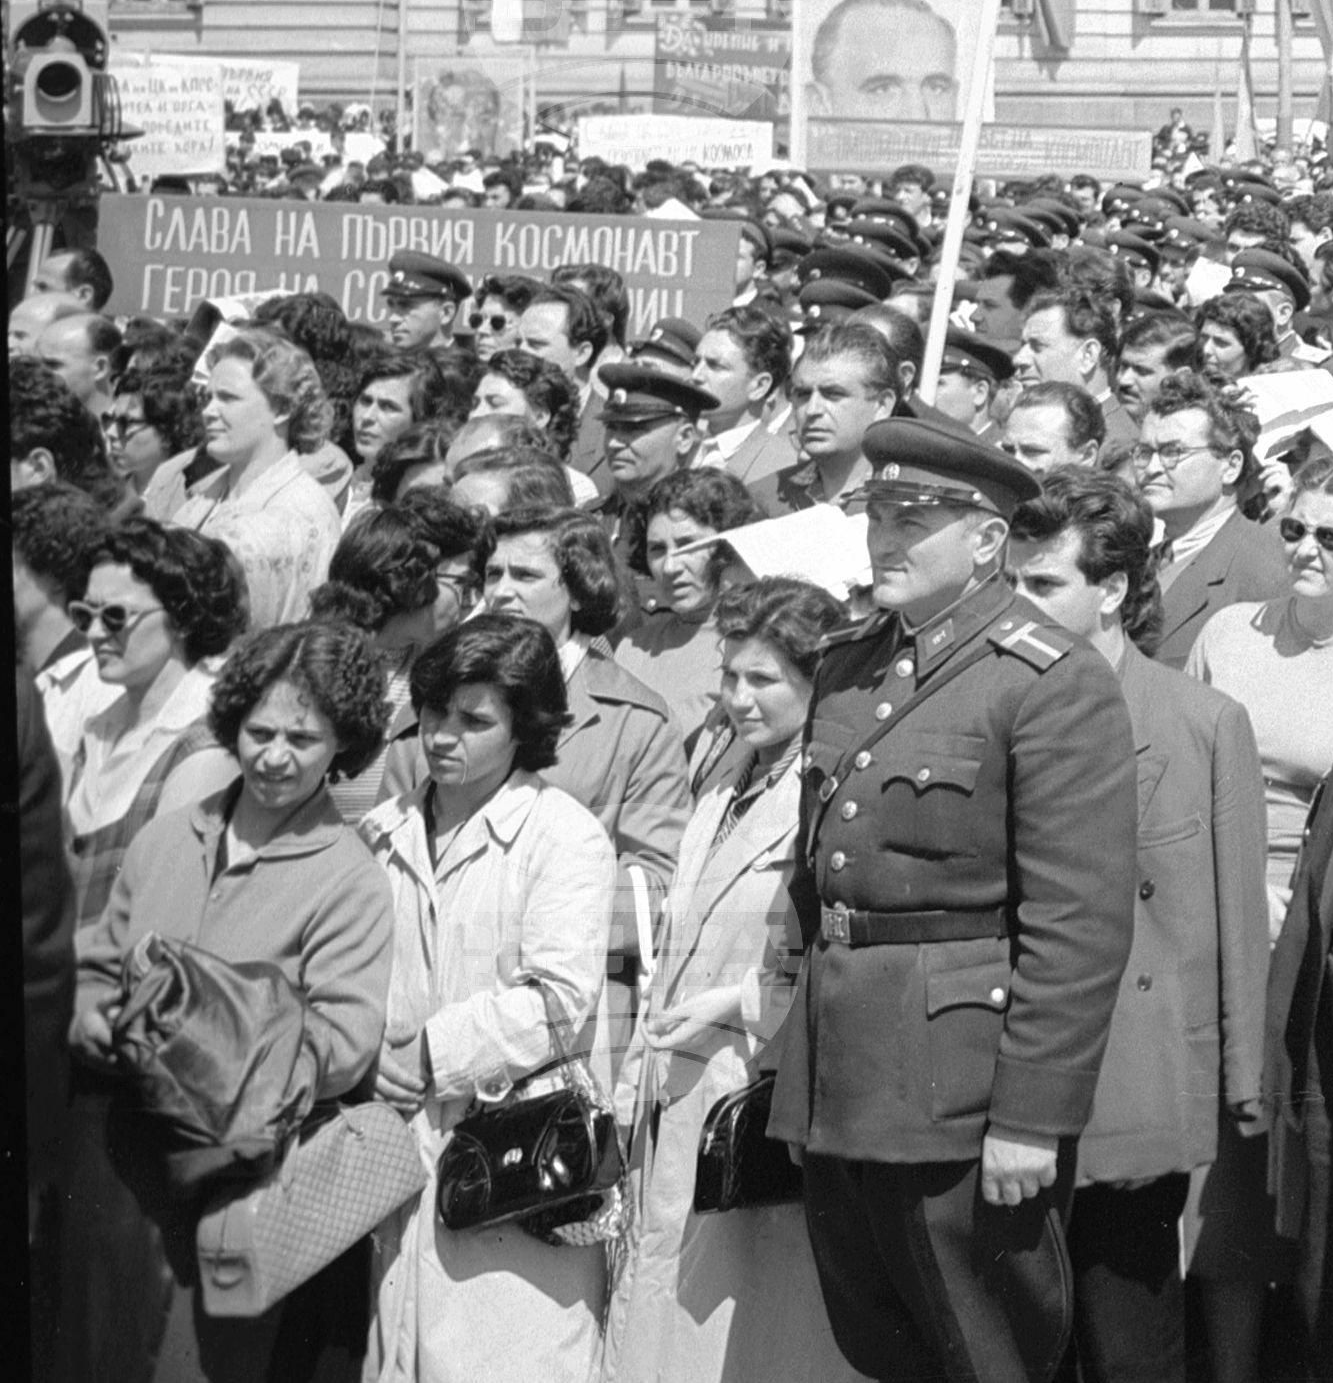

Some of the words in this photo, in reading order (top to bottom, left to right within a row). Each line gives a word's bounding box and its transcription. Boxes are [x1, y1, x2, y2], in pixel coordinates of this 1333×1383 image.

[144, 198, 251, 255] СЛАВА
[275, 210, 320, 259] НА
[494, 221, 700, 277] КОСМОНАВТ
